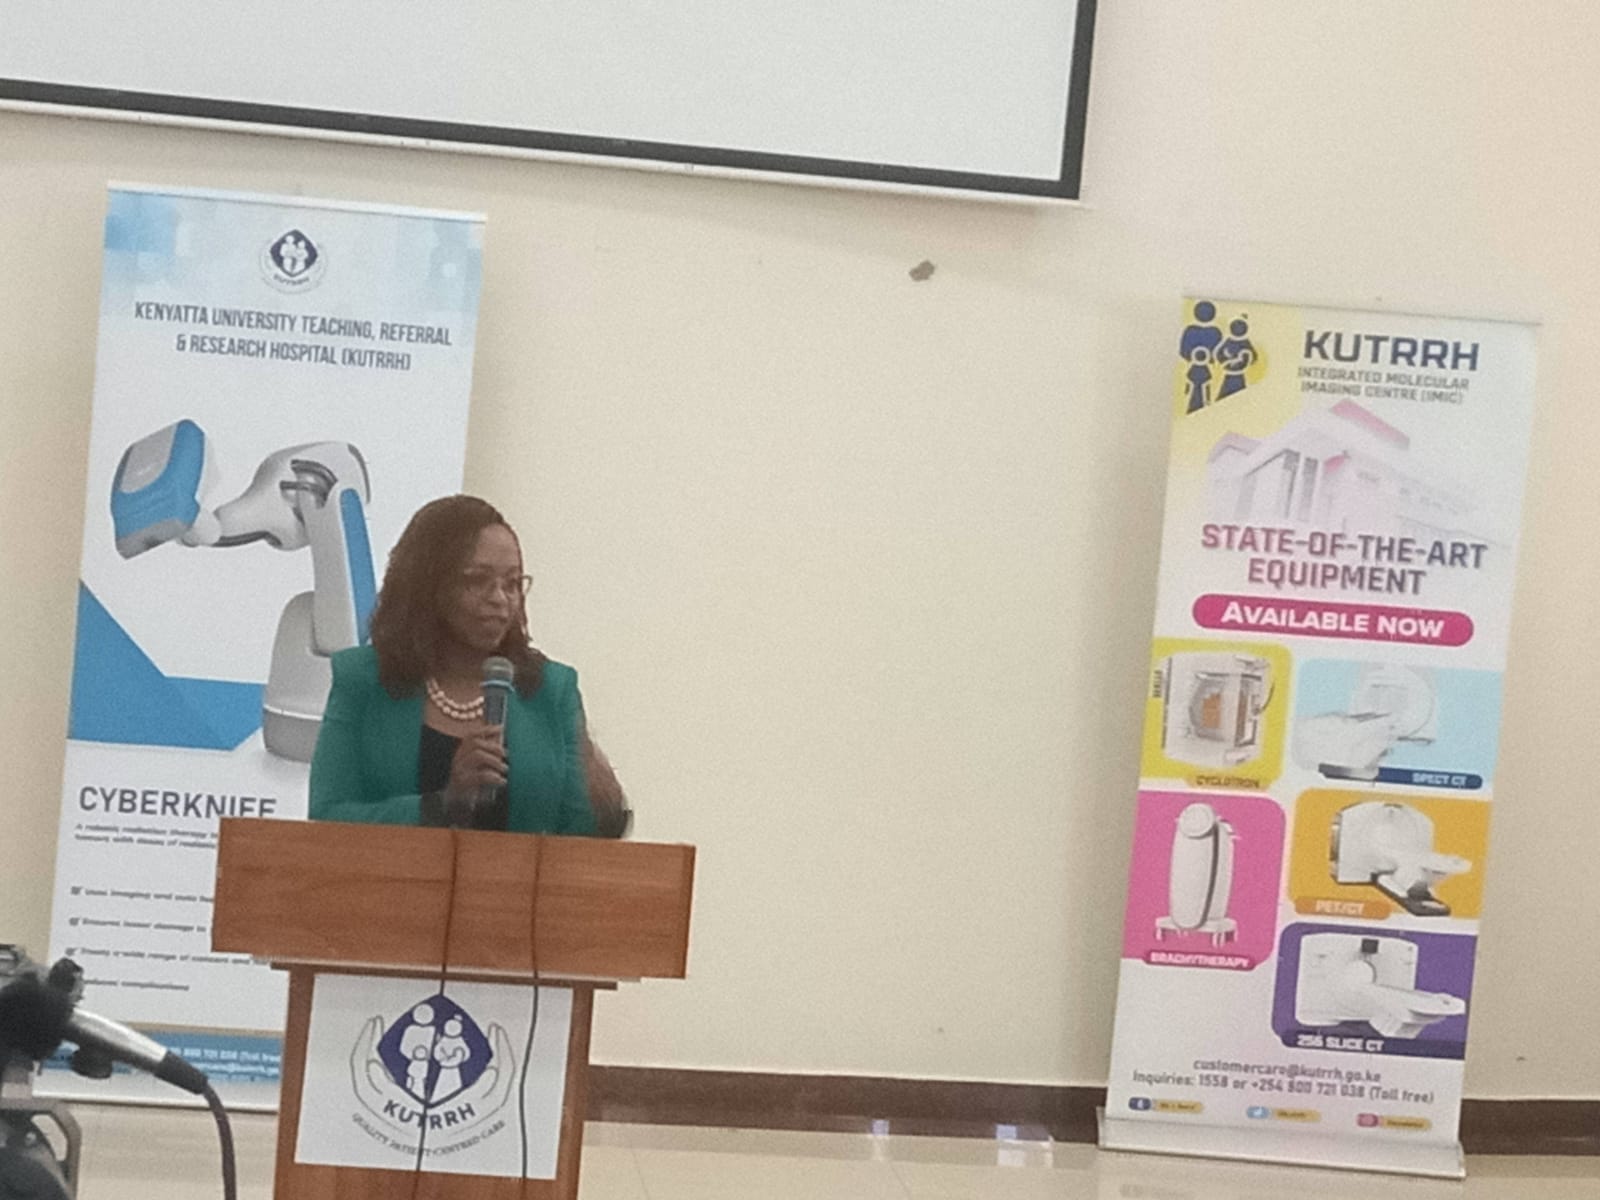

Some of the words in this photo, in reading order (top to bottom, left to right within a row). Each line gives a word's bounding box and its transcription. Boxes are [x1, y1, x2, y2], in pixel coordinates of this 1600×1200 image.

[135, 301, 208, 325] KENYATTA
[211, 307, 298, 332] UNIVERSITY
[301, 315, 375, 341] TEACHING,
[379, 321, 452, 346] REFERRAL
[176, 334, 187, 352] &
[190, 335, 266, 358] RESEARCH
[270, 342, 337, 365] HOSPITAL
[341, 347, 412, 371] (KUTRRH)
[1303, 330, 1480, 371] KUTRRH
[1298, 367, 1383, 384] INTEGRATED
[1385, 372, 1470, 390] MOLECULAR
[1300, 380, 1361, 397] IMAGING
[1364, 385, 1417, 401] CENTRE
[1201, 523, 1488, 569] STATE-OF-THE-ART
[1247, 557, 1427, 596] EQUIPMENT
[1376, 614, 1446, 639] NOW
[1367, 1039, 1385, 1052] CT
[1199, 1074, 1229, 1089] 1558
[1232, 1079, 1248, 1090] or
[1251, 1079, 1284, 1093] +254
[1369, 1086, 1399, 1101] (Toll
[1402, 1089, 1435, 1105] free)
[352, 1113, 389, 1145] QUALITY
[480, 1119, 506, 1140] CARE
[383, 1099, 476, 1130] KUTRRH
